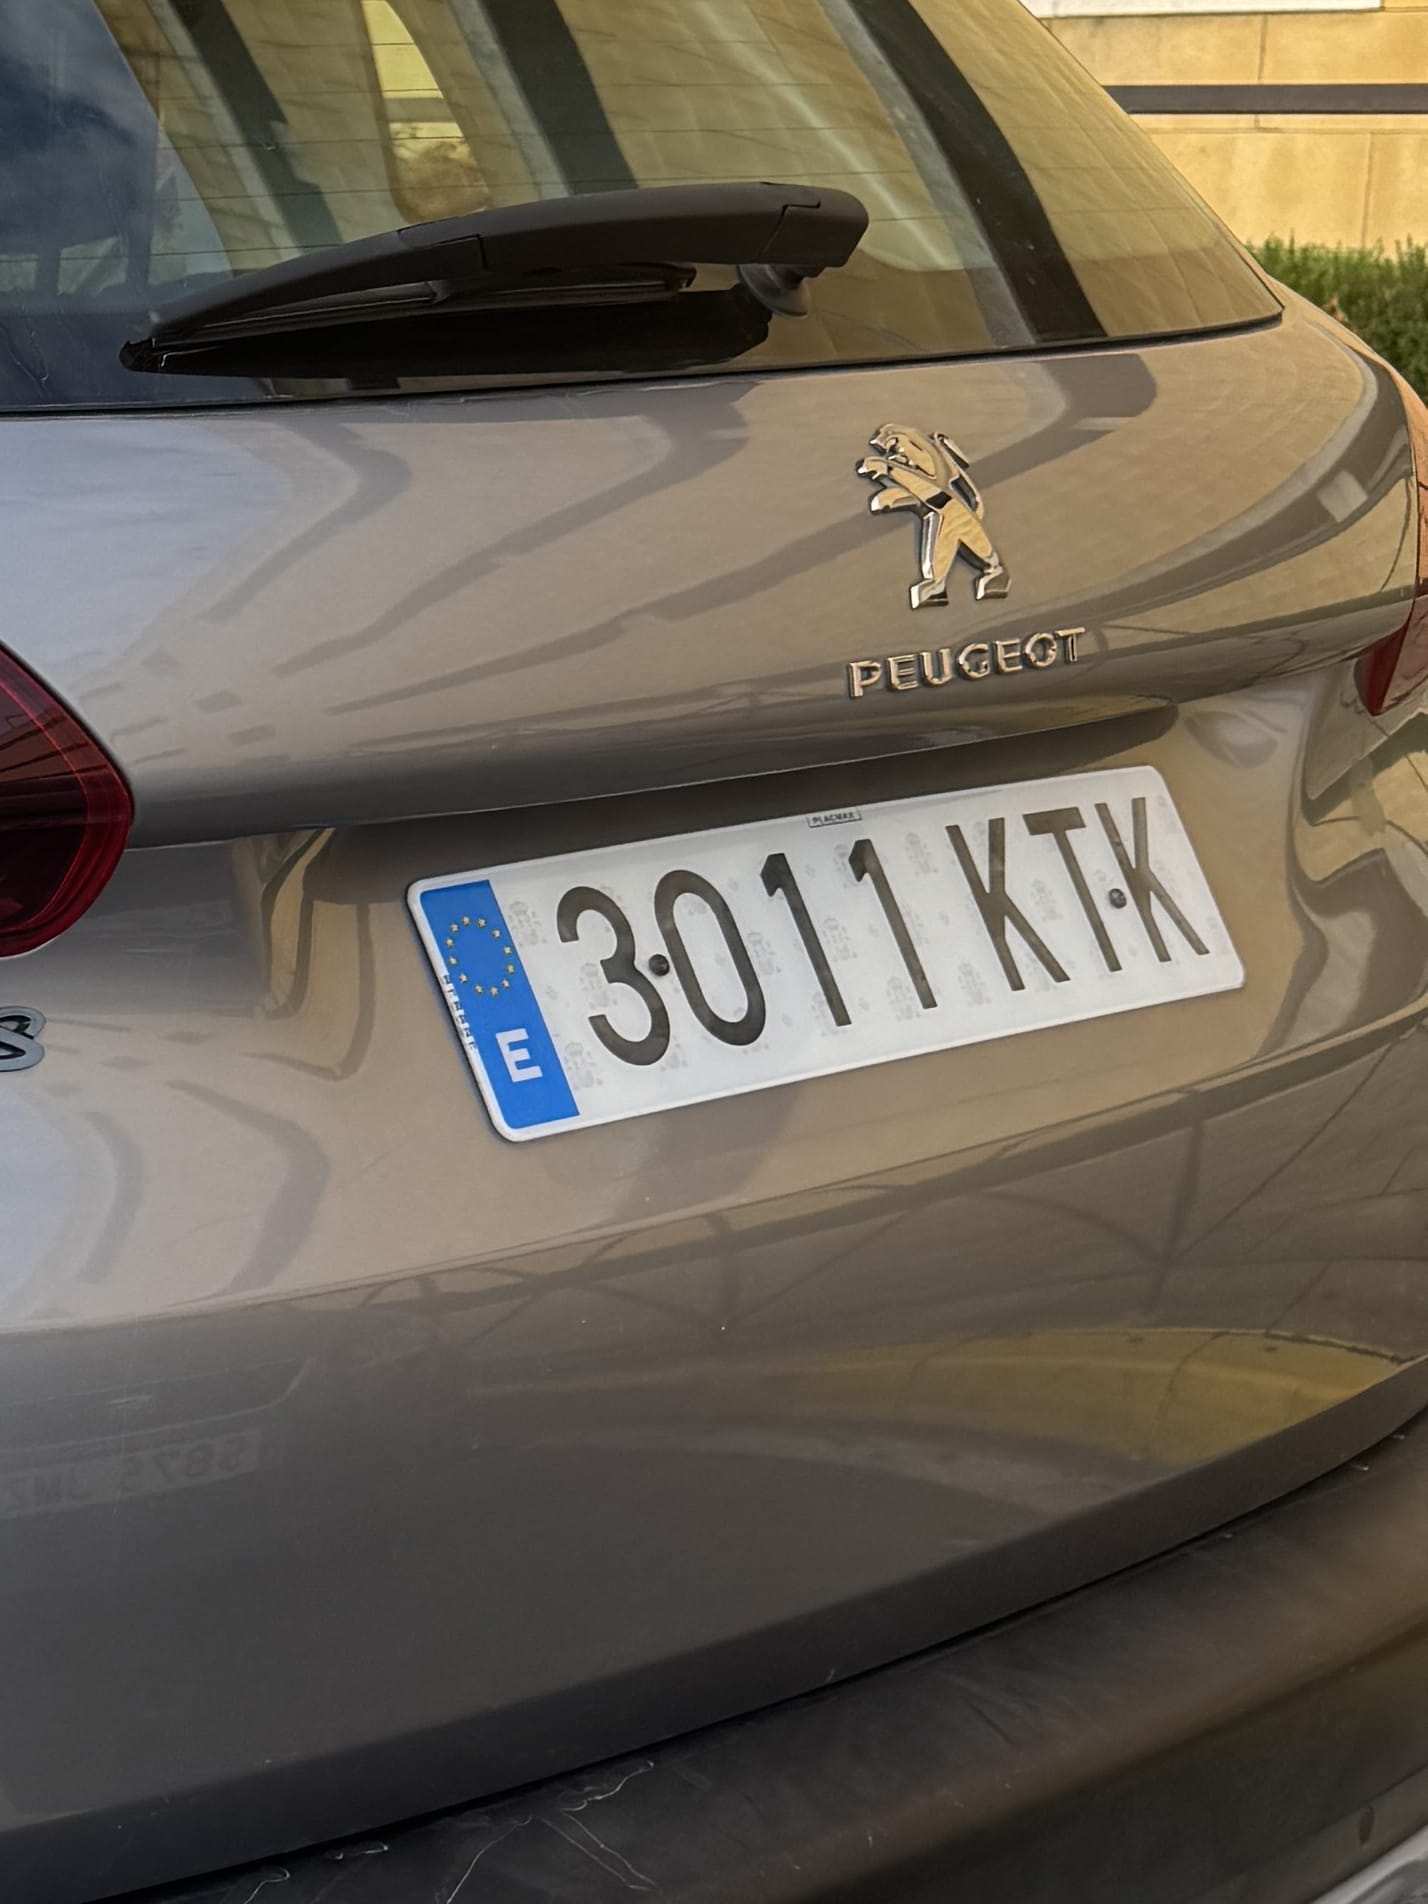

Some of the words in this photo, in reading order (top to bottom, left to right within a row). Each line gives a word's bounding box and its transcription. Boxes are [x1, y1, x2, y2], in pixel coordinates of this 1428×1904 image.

[847, 626, 1086, 699] PEUGEOT
[556, 838, 938, 1067] 3011
[945, 796, 1211, 992] KTK
[496, 1027, 543, 1083] E
